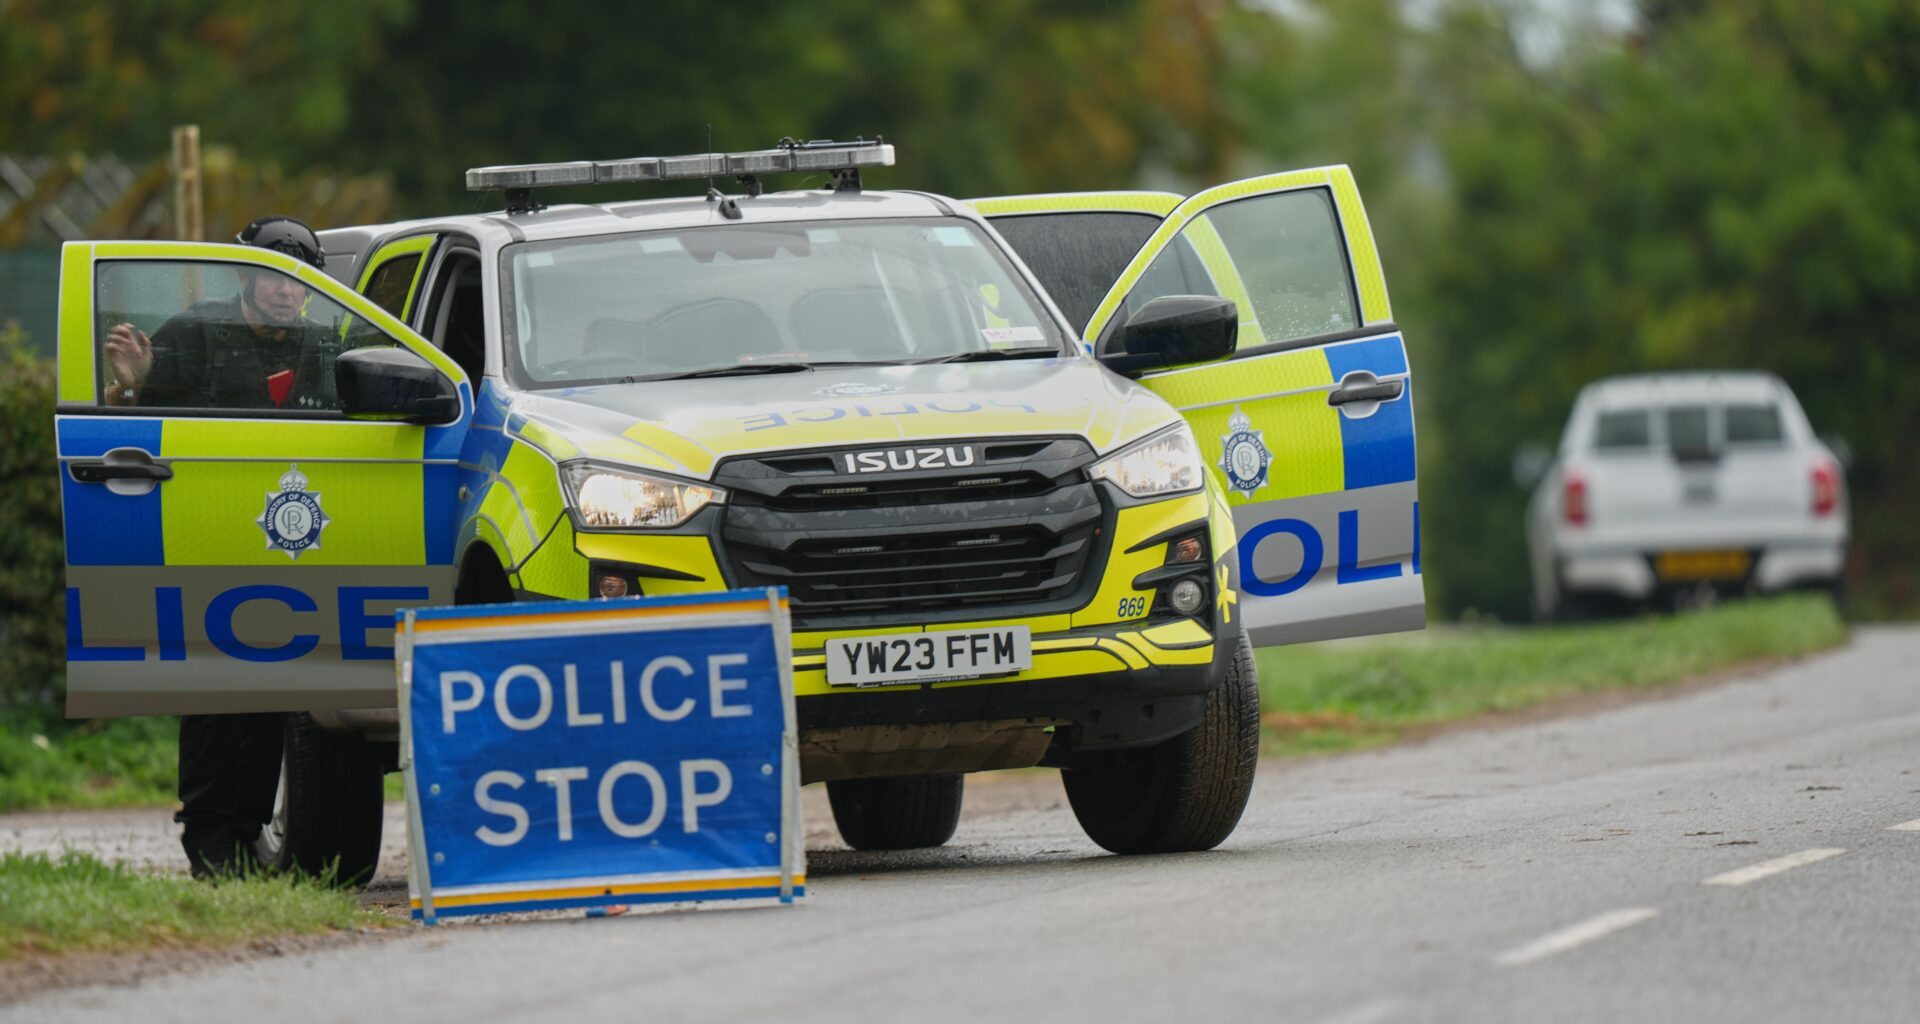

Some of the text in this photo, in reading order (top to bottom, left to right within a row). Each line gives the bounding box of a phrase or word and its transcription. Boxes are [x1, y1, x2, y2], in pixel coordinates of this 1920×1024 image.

[844, 446, 974, 474] ISUZU
[1247, 436, 1267, 467] DEFENCE
[1235, 477, 1260, 489] POLICE
[266, 493, 320, 531] MINISTRY OF DEFENCE
[277, 537, 311, 549] POLICE
[66, 584, 429, 662] LICE
[1117, 597, 1145, 618] 869
[842, 631, 1015, 676] YW23 FFM
[439, 653, 753, 734] POLICE
[474, 758, 733, 847] STOP
